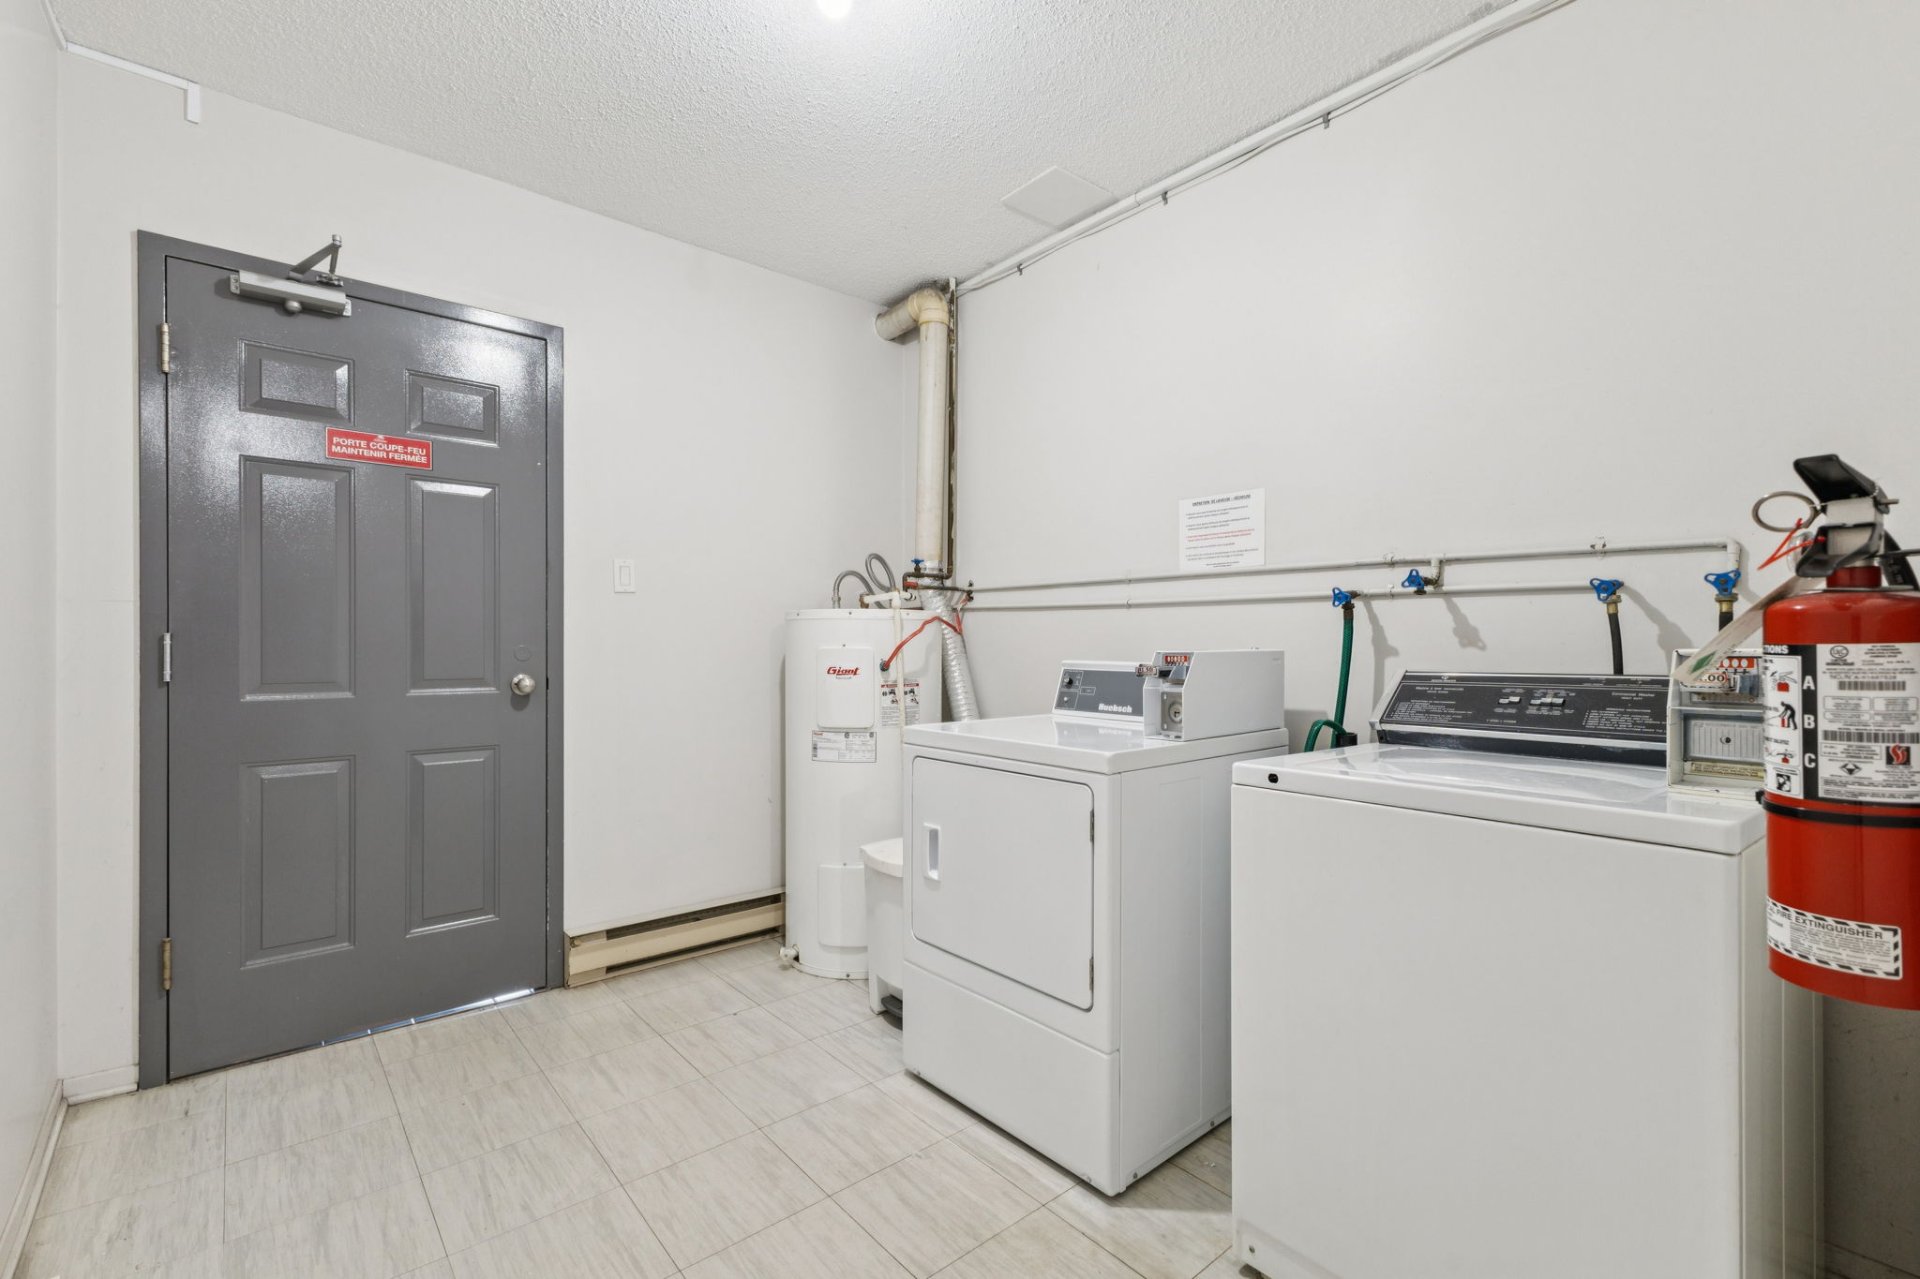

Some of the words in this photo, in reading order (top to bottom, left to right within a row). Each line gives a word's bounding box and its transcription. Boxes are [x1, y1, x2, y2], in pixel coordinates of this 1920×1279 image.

[333, 437, 367, 448] PORTE
[370, 442, 426, 455] COUPE-FEU
[332, 445, 387, 458] MAINTENIR
[389, 452, 428, 463] FERMÉE
[827, 666, 859, 676] Giant
[1802, 675, 1816, 690] A
[1803, 714, 1816, 729] B
[1804, 753, 1817, 768] C
[1777, 910, 1792, 920] FIRE
[1794, 917, 1883, 939] EXTINGUISHER
